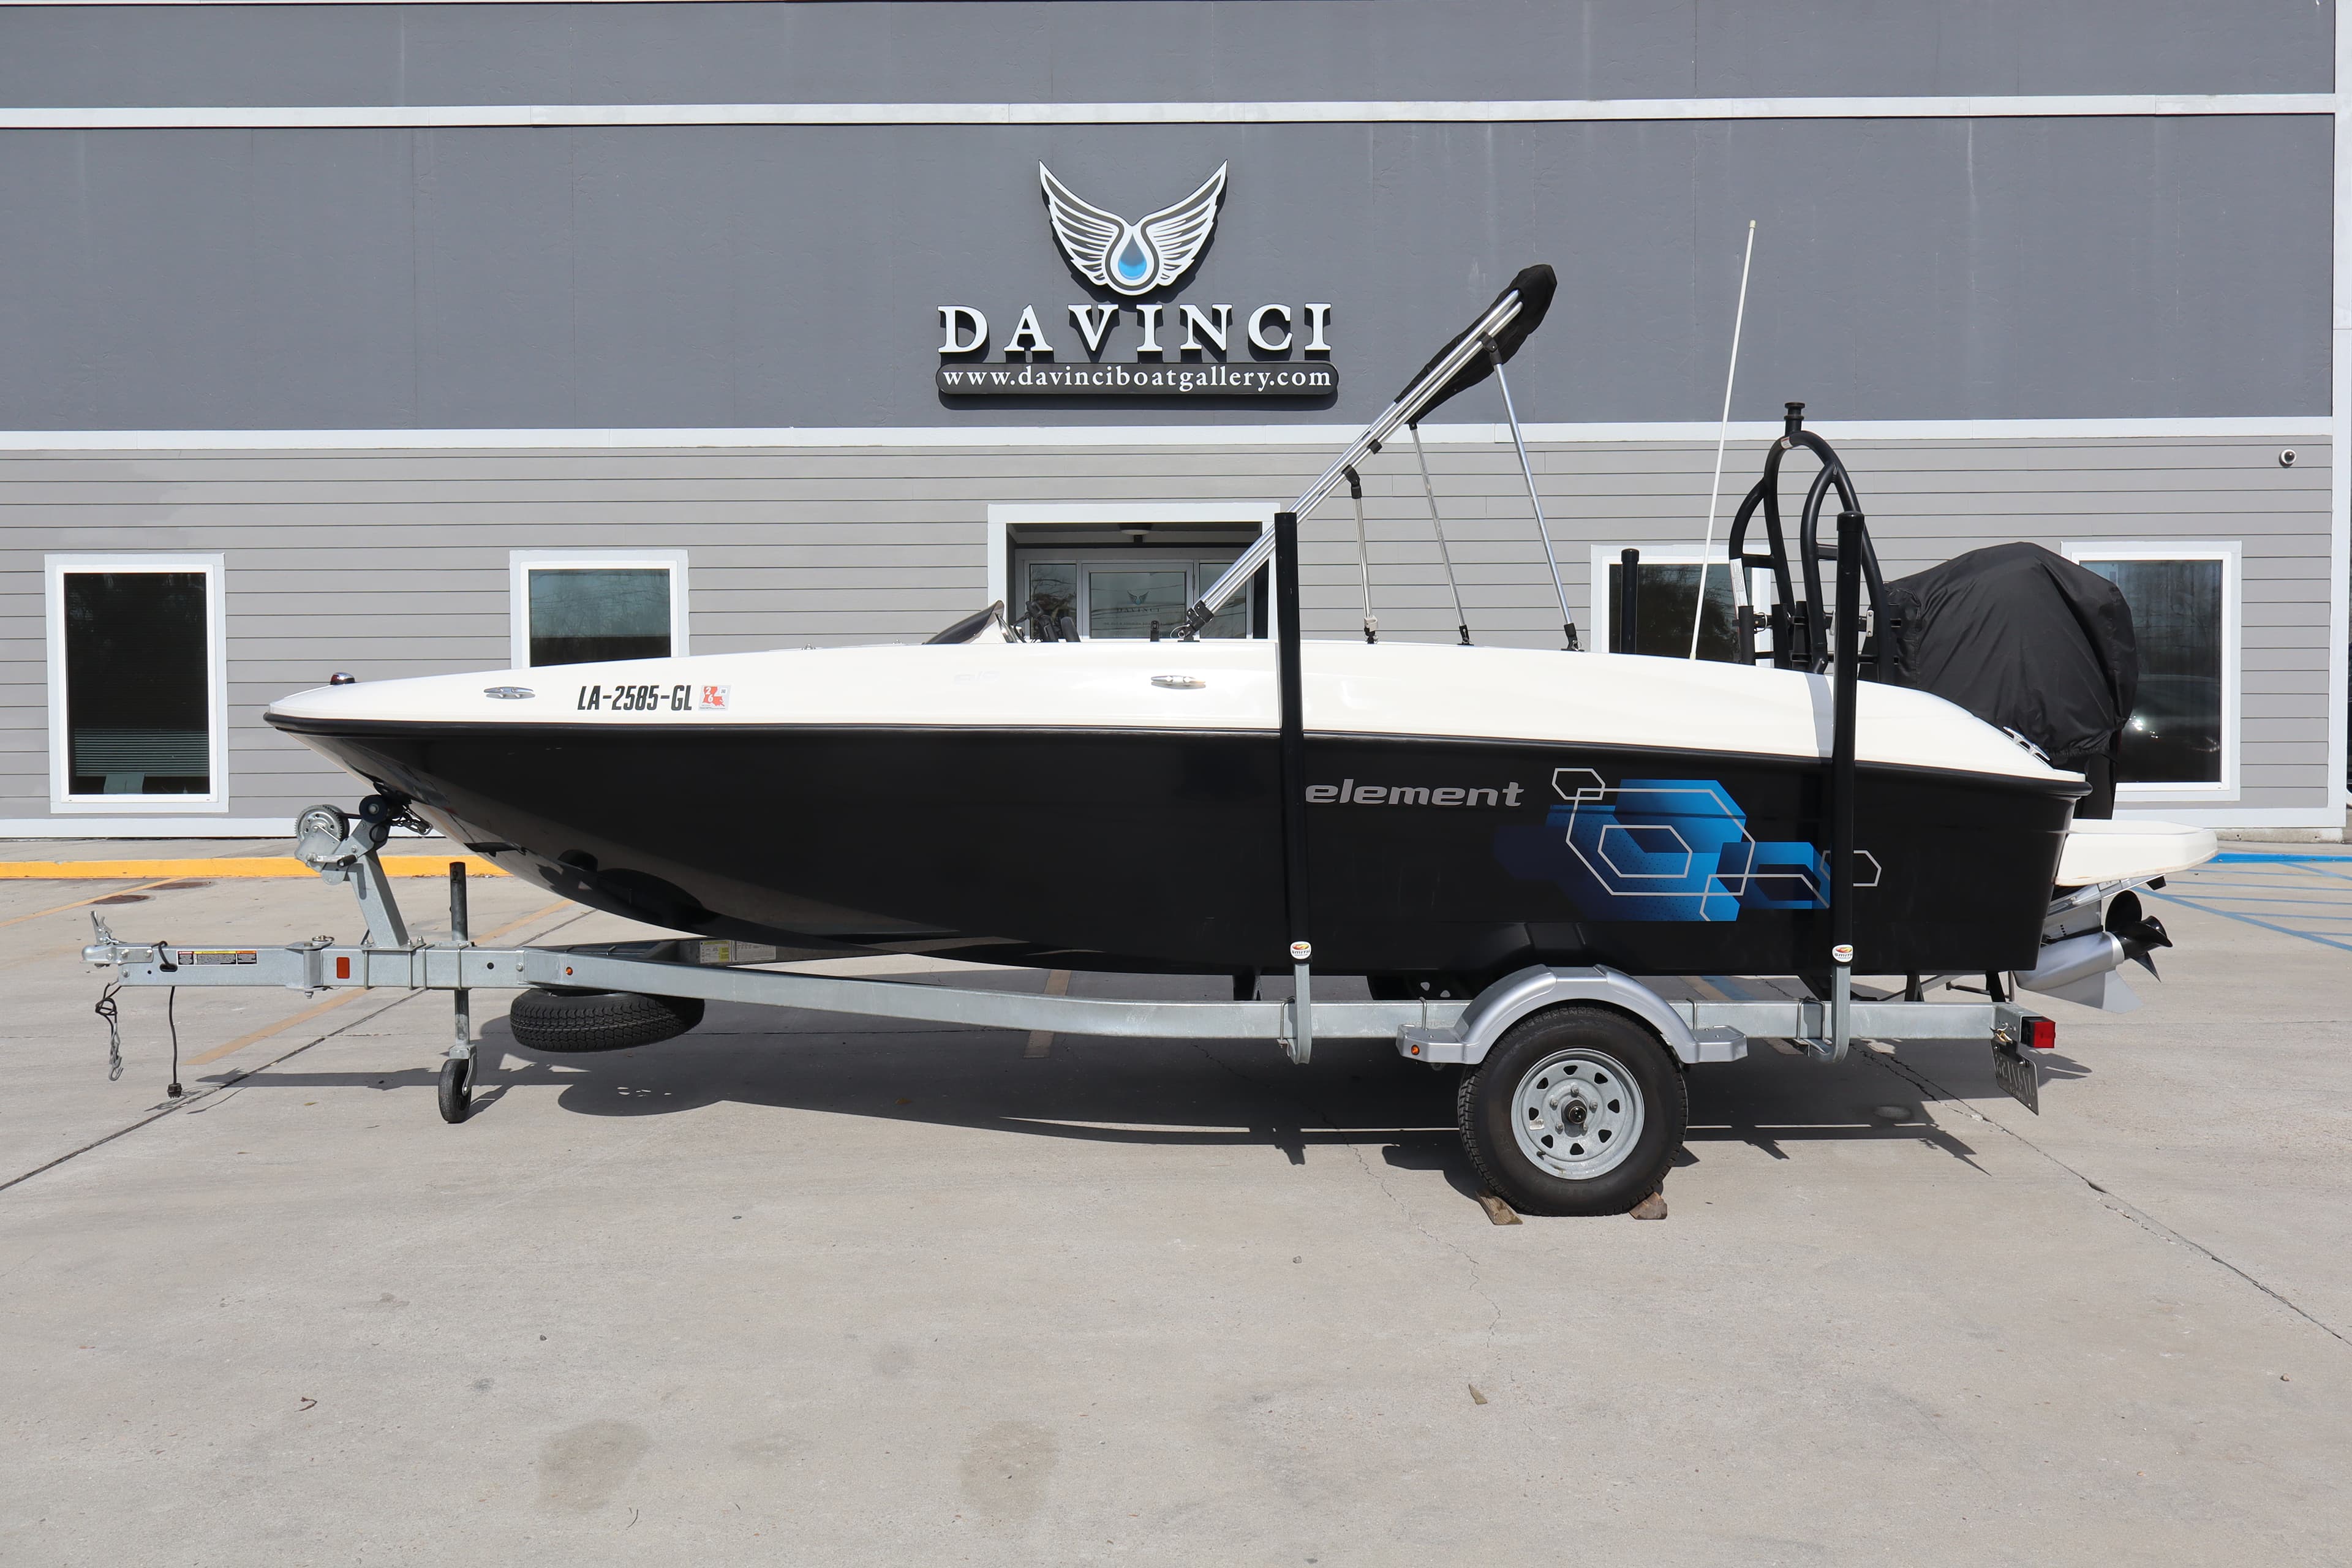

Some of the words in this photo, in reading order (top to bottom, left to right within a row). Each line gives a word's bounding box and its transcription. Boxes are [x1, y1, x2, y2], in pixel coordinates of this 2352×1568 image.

[937, 303, 1332, 353] DAVINCI
[942, 364, 1332, 393] www.davinciboatgallery.com
[577, 685, 692, 711] LA-2585-GL
[1305, 778, 1525, 807] element
